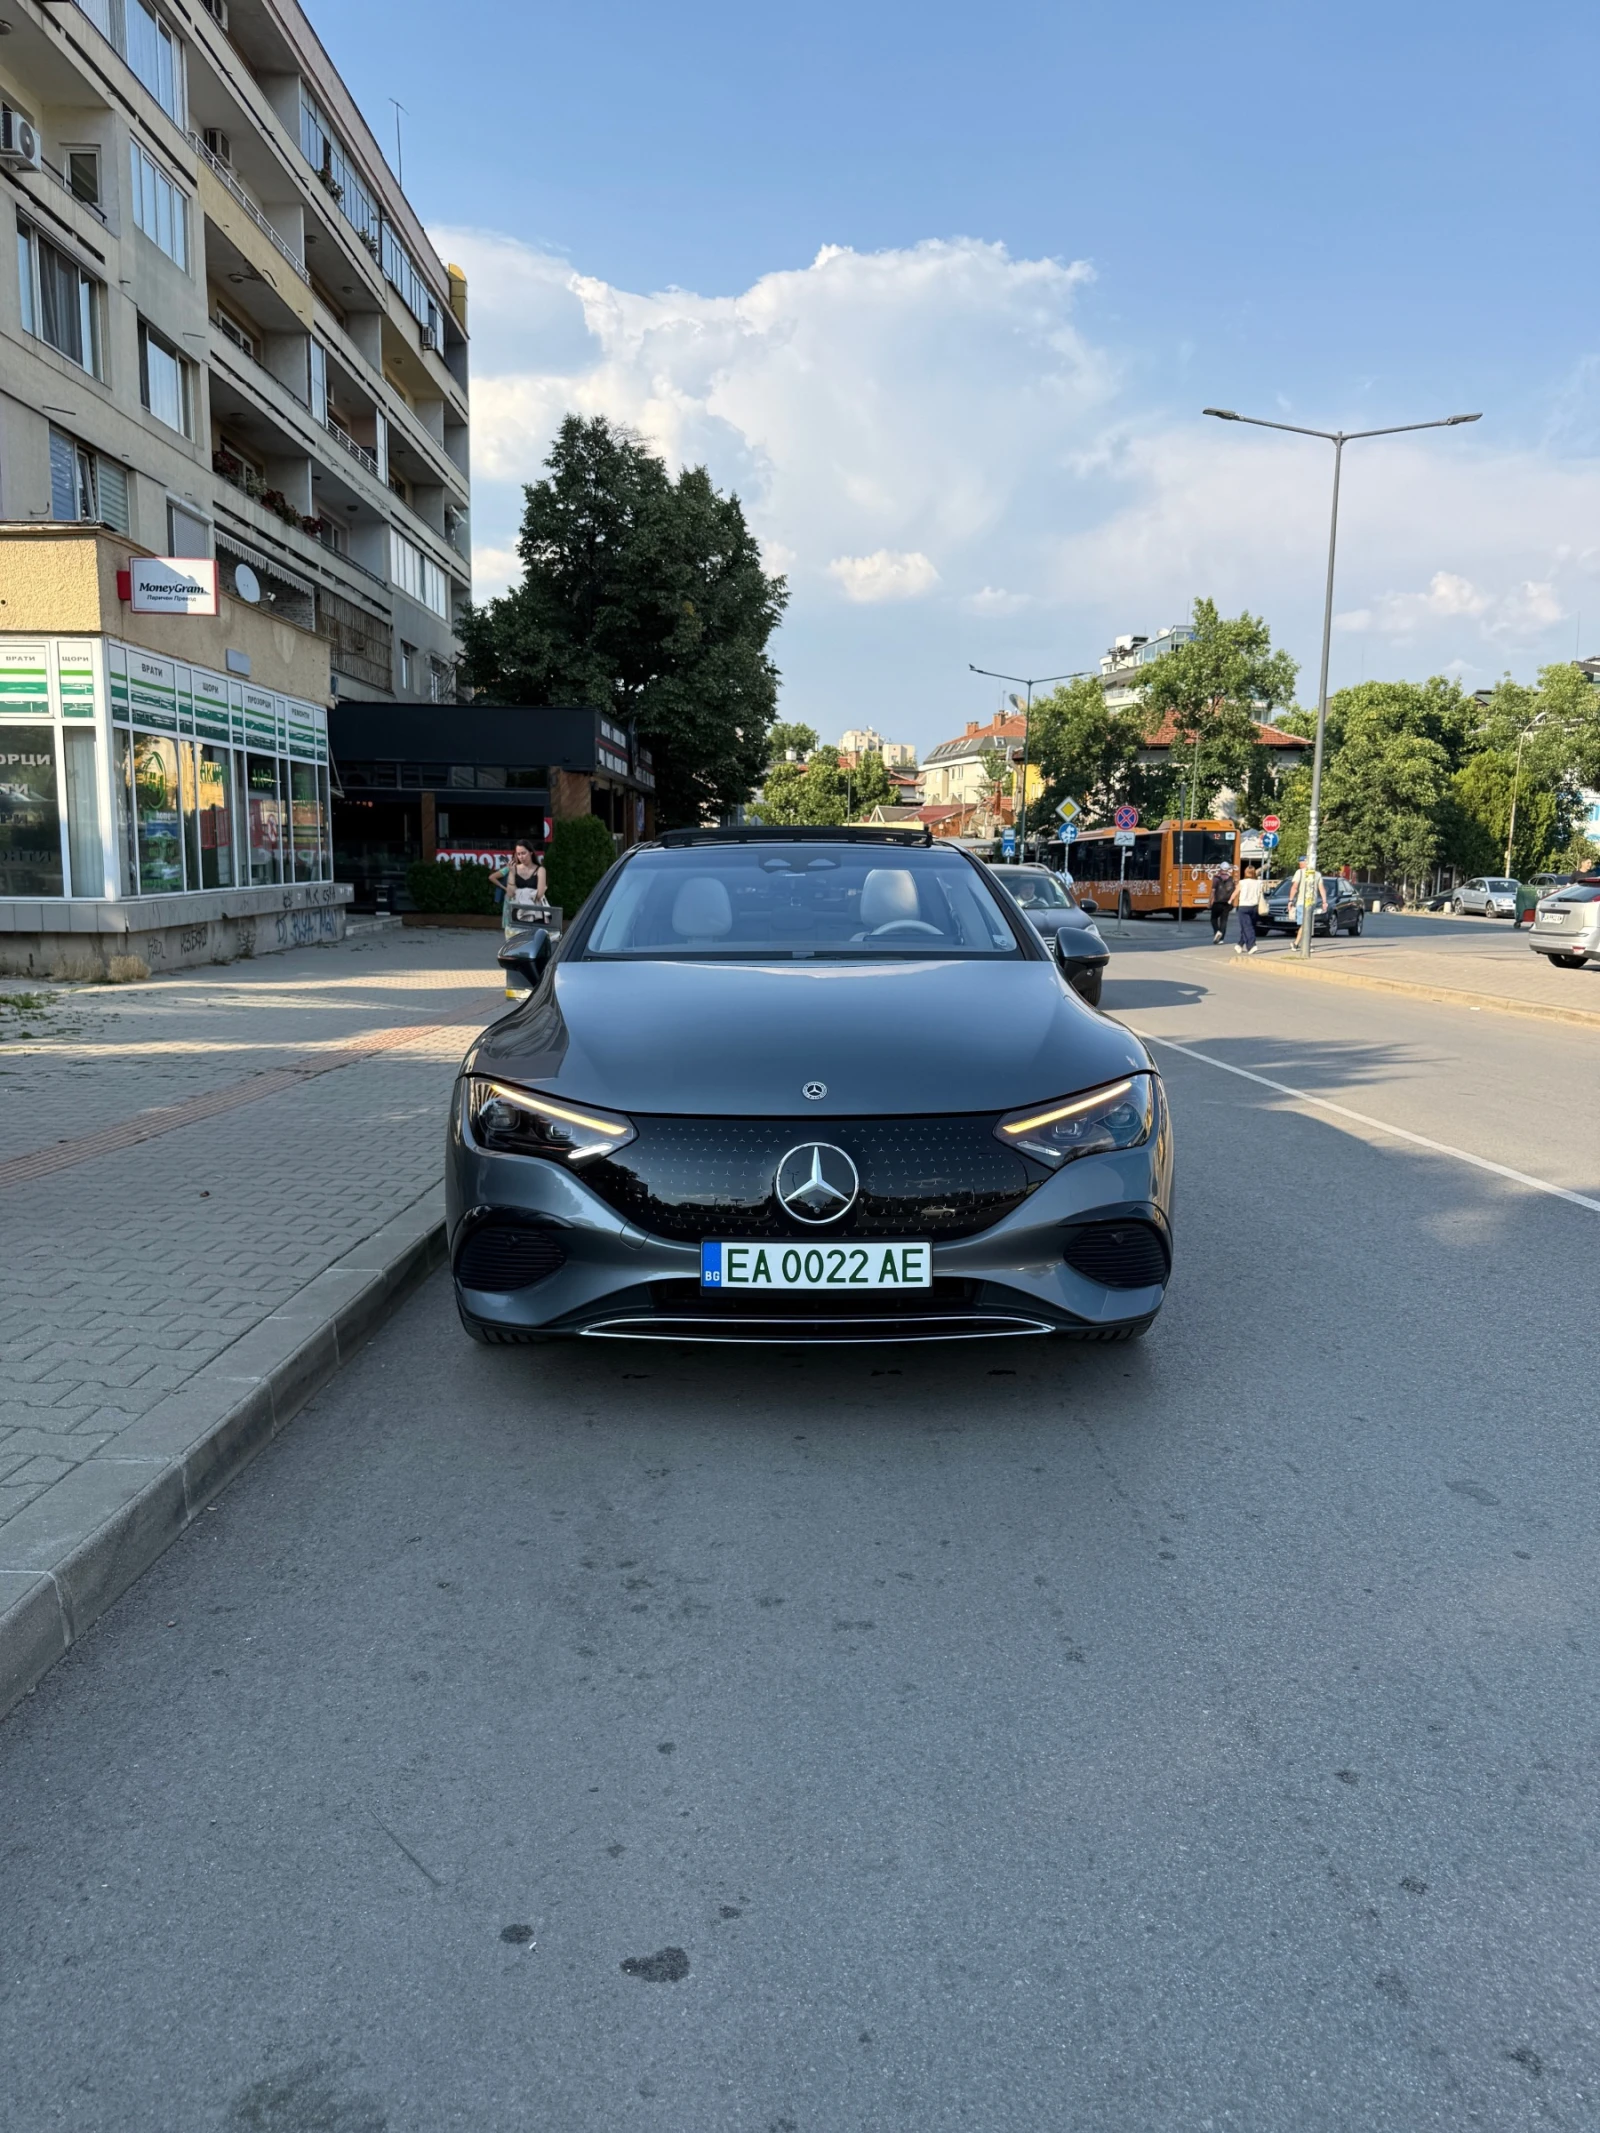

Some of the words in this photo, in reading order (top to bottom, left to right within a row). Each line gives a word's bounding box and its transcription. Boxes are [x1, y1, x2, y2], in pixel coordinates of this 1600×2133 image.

[139, 582, 204, 595] MoneyGram
[141, 663, 163, 678] ВРАТИ
[202, 682, 220, 694] ЩОРИ
[727, 1248, 772, 1283] EA
[782, 1248, 869, 1283] 0022
[878, 1248, 924, 1283] AE
[705, 1271, 720, 1282] BG
